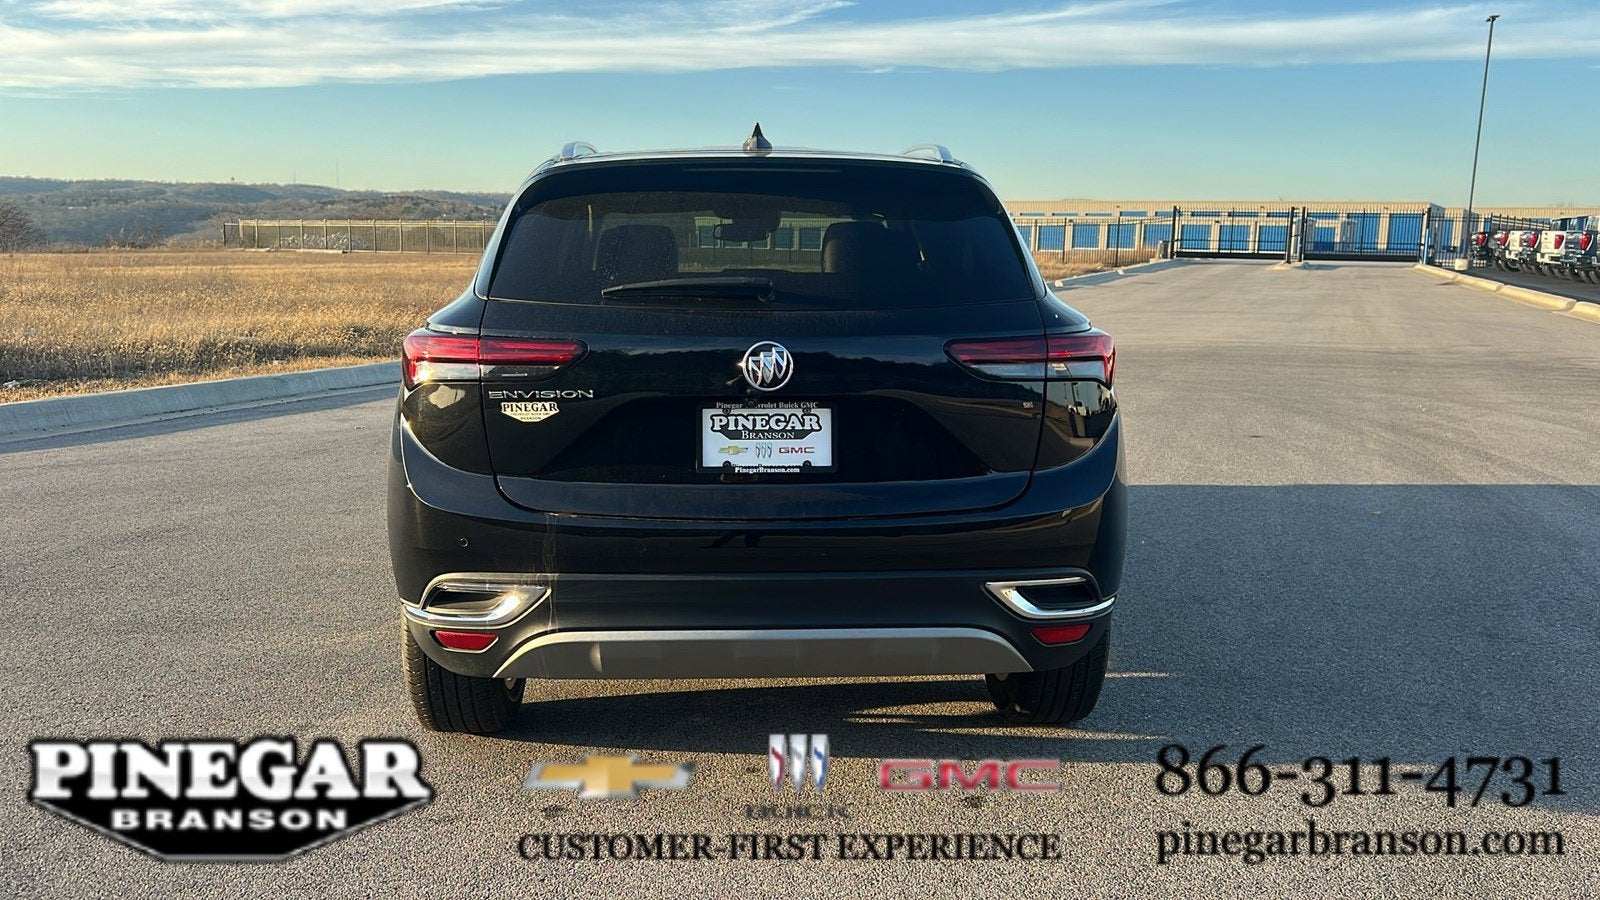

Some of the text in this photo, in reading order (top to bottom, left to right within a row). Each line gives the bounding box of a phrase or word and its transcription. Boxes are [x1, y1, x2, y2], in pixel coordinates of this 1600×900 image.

[488, 390, 594, 399] ENVISION
[502, 403, 558, 412] PINEGAR
[716, 402, 743, 410] Pinegar
[711, 415, 821, 431] PINEGAR
[741, 430, 795, 439] BRANSON
[778, 446, 815, 454] GMC
[734, 466, 801, 474] PinegarBranson.com
